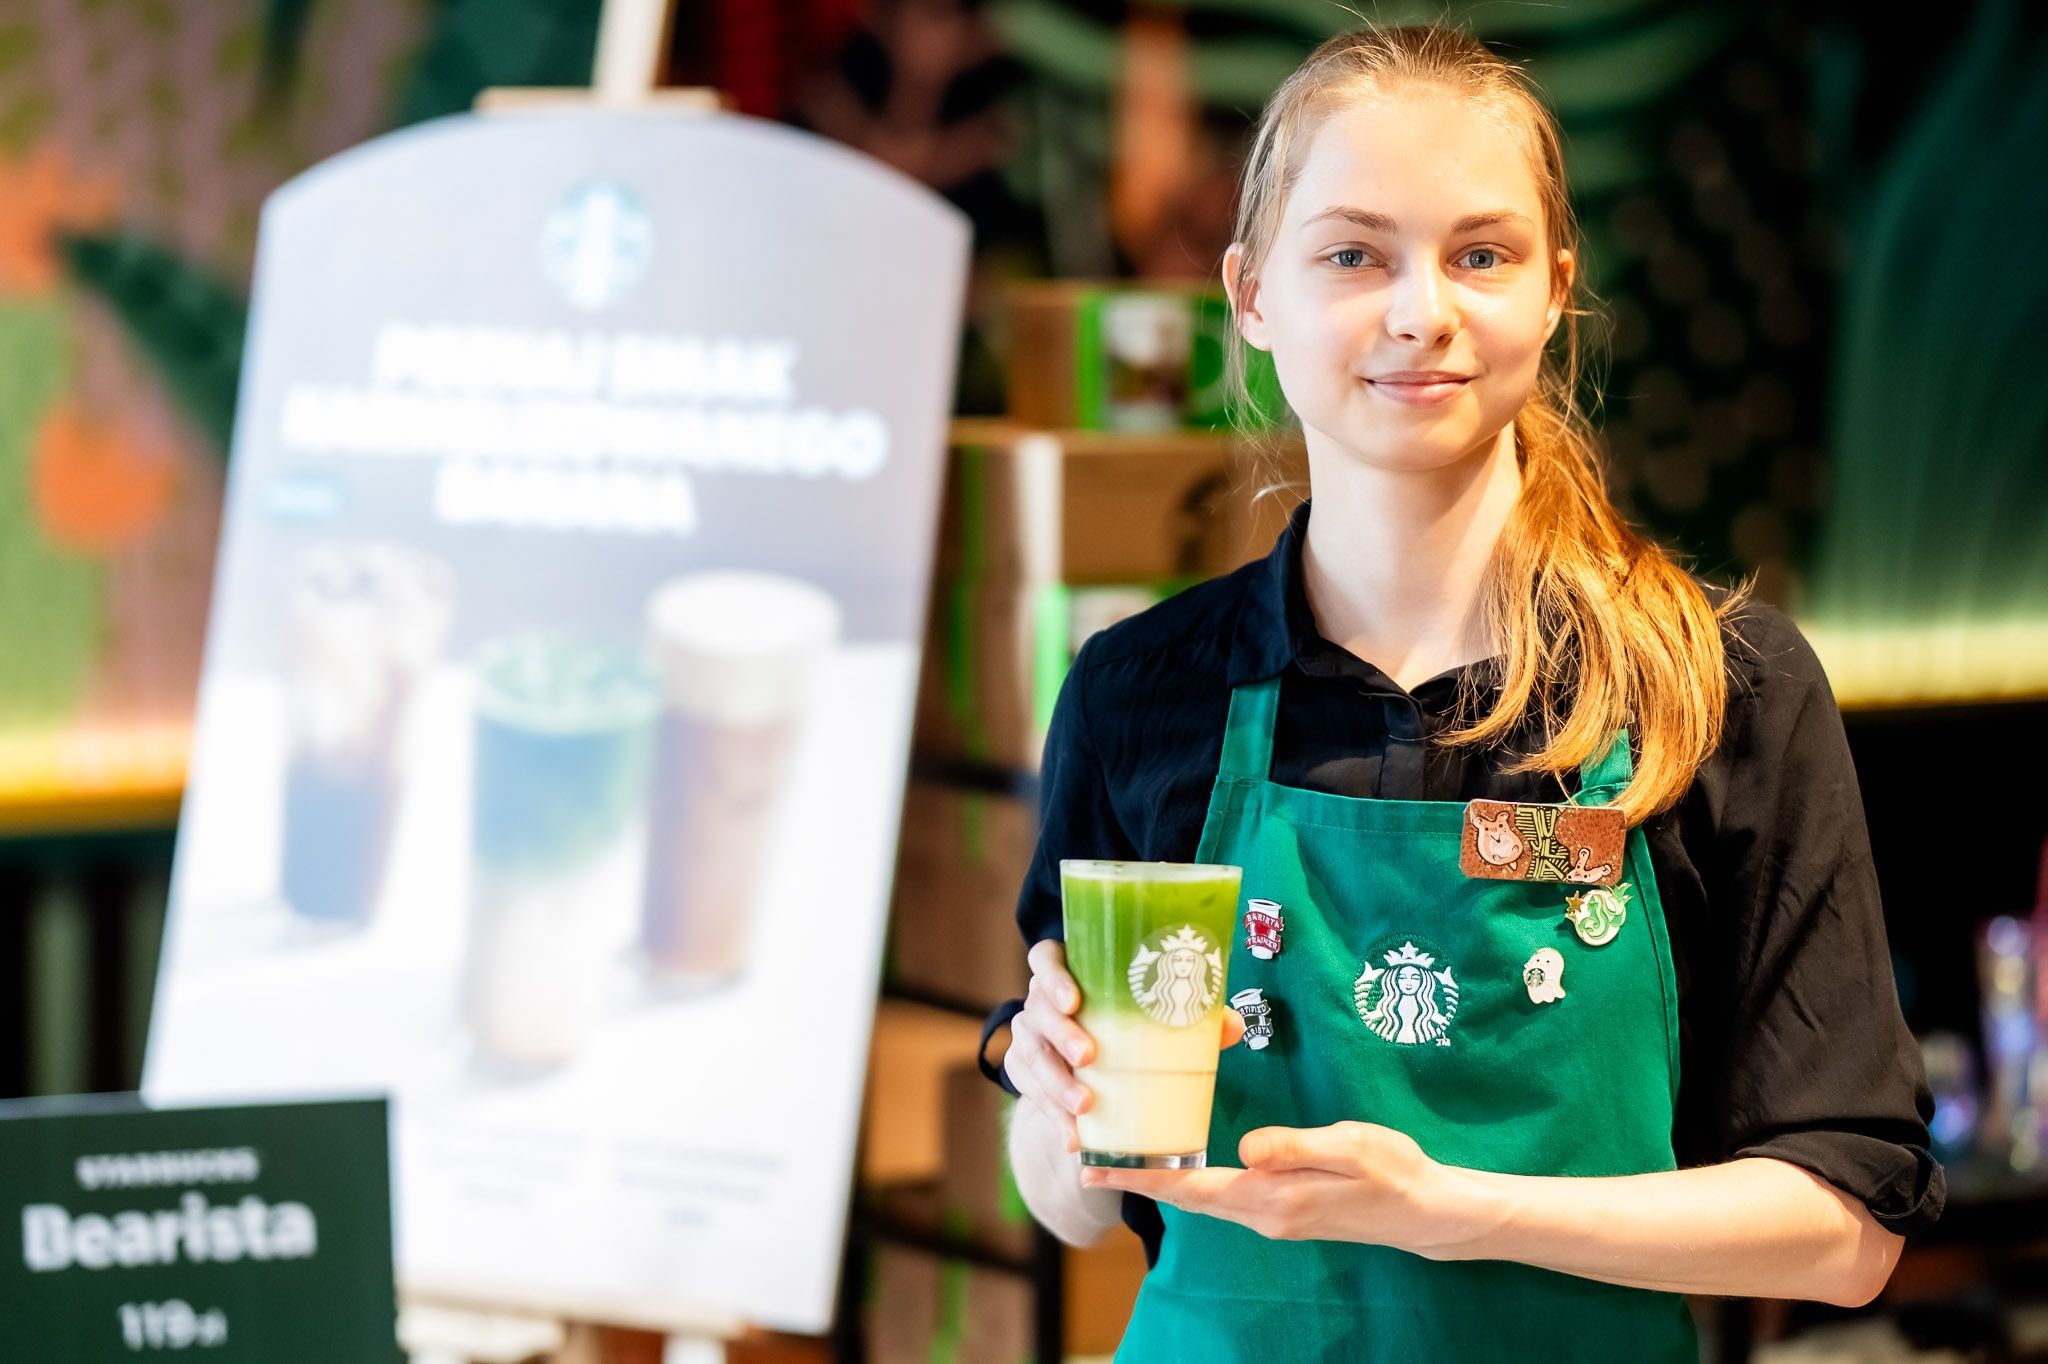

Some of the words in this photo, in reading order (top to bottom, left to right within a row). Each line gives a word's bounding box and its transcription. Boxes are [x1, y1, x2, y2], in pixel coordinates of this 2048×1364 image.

[1246, 912, 1280, 929] BARISTA
[1246, 935, 1278, 951] TRAINER
[1240, 1003, 1267, 1016] RTIFIED
[75, 1147, 261, 1190] STARBUCKS
[22, 1191, 318, 1273] Bearista
